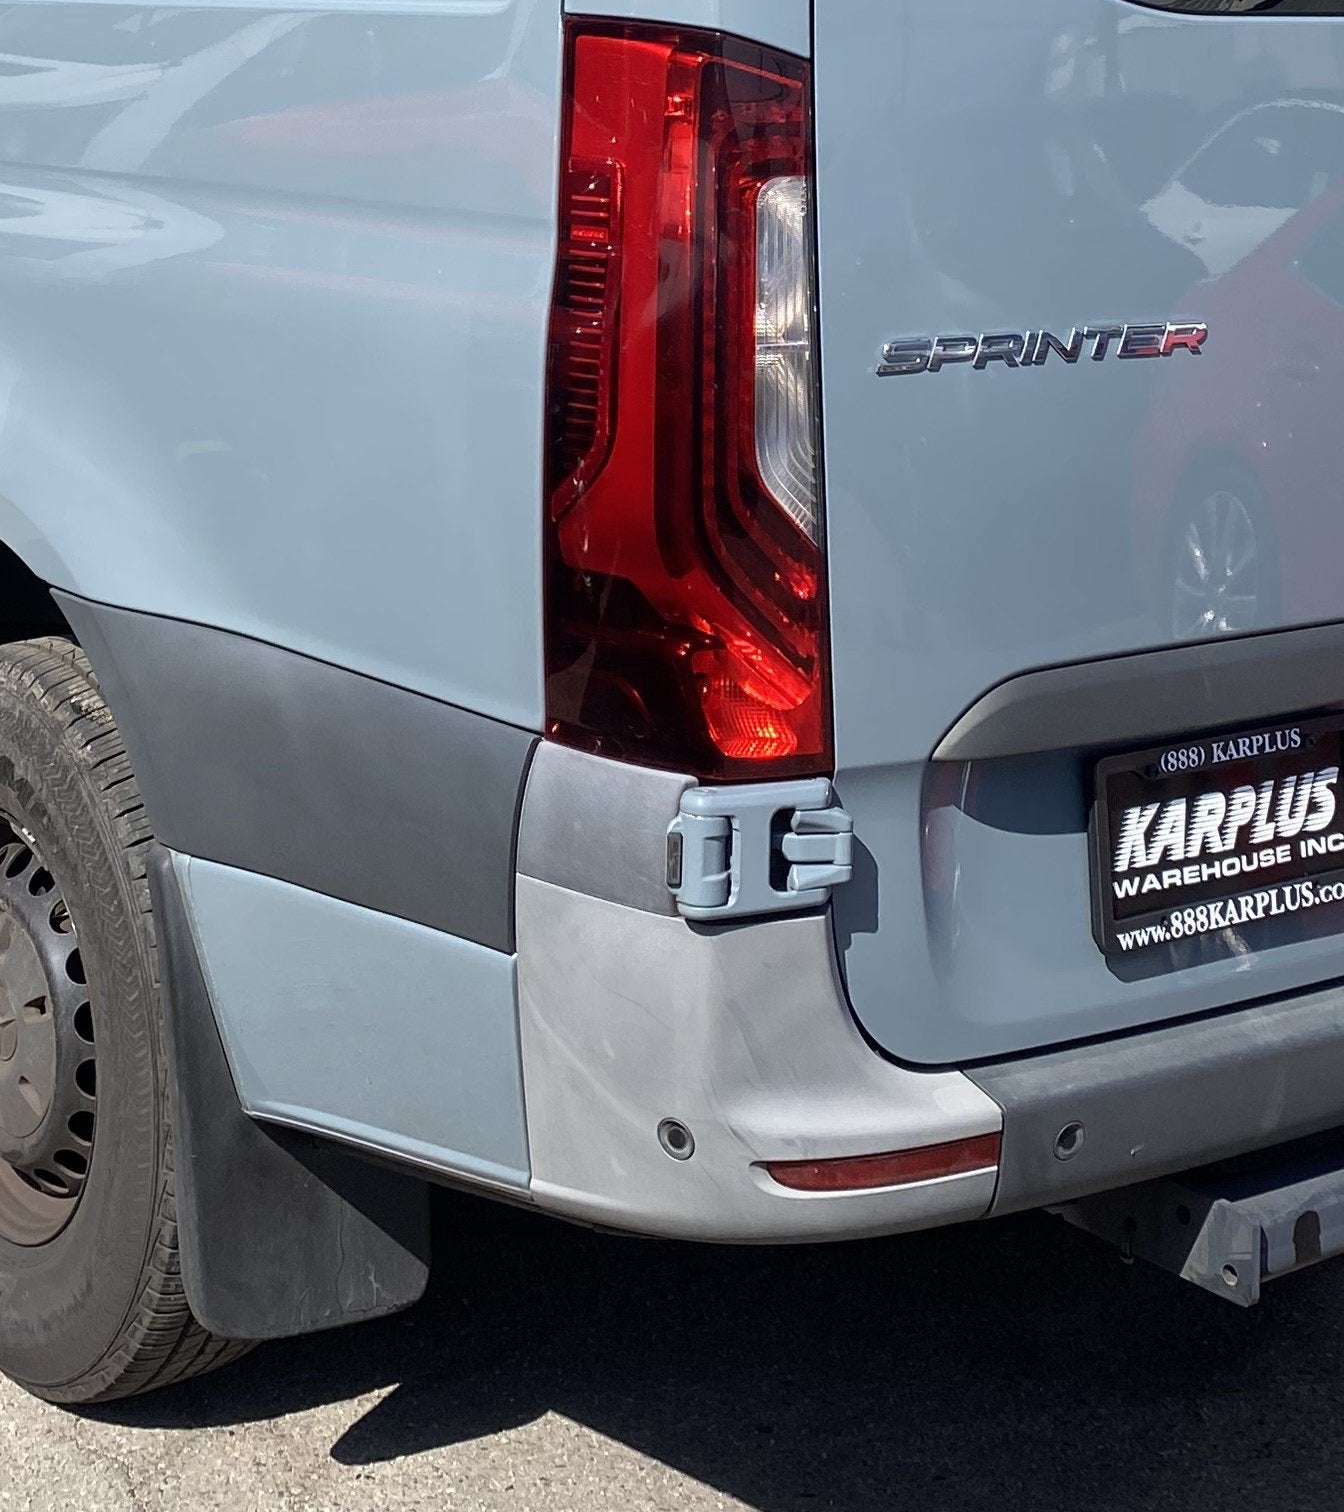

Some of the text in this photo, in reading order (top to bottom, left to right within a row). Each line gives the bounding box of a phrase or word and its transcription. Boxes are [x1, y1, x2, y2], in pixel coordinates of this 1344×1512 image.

[874, 321, 1209, 378] SPRINTER
[1159, 727, 1302, 773] (888) KARPLUS
[1112, 766, 1340, 873] KARPLUS
[1112, 844, 1292, 900] WAREHOUSE
